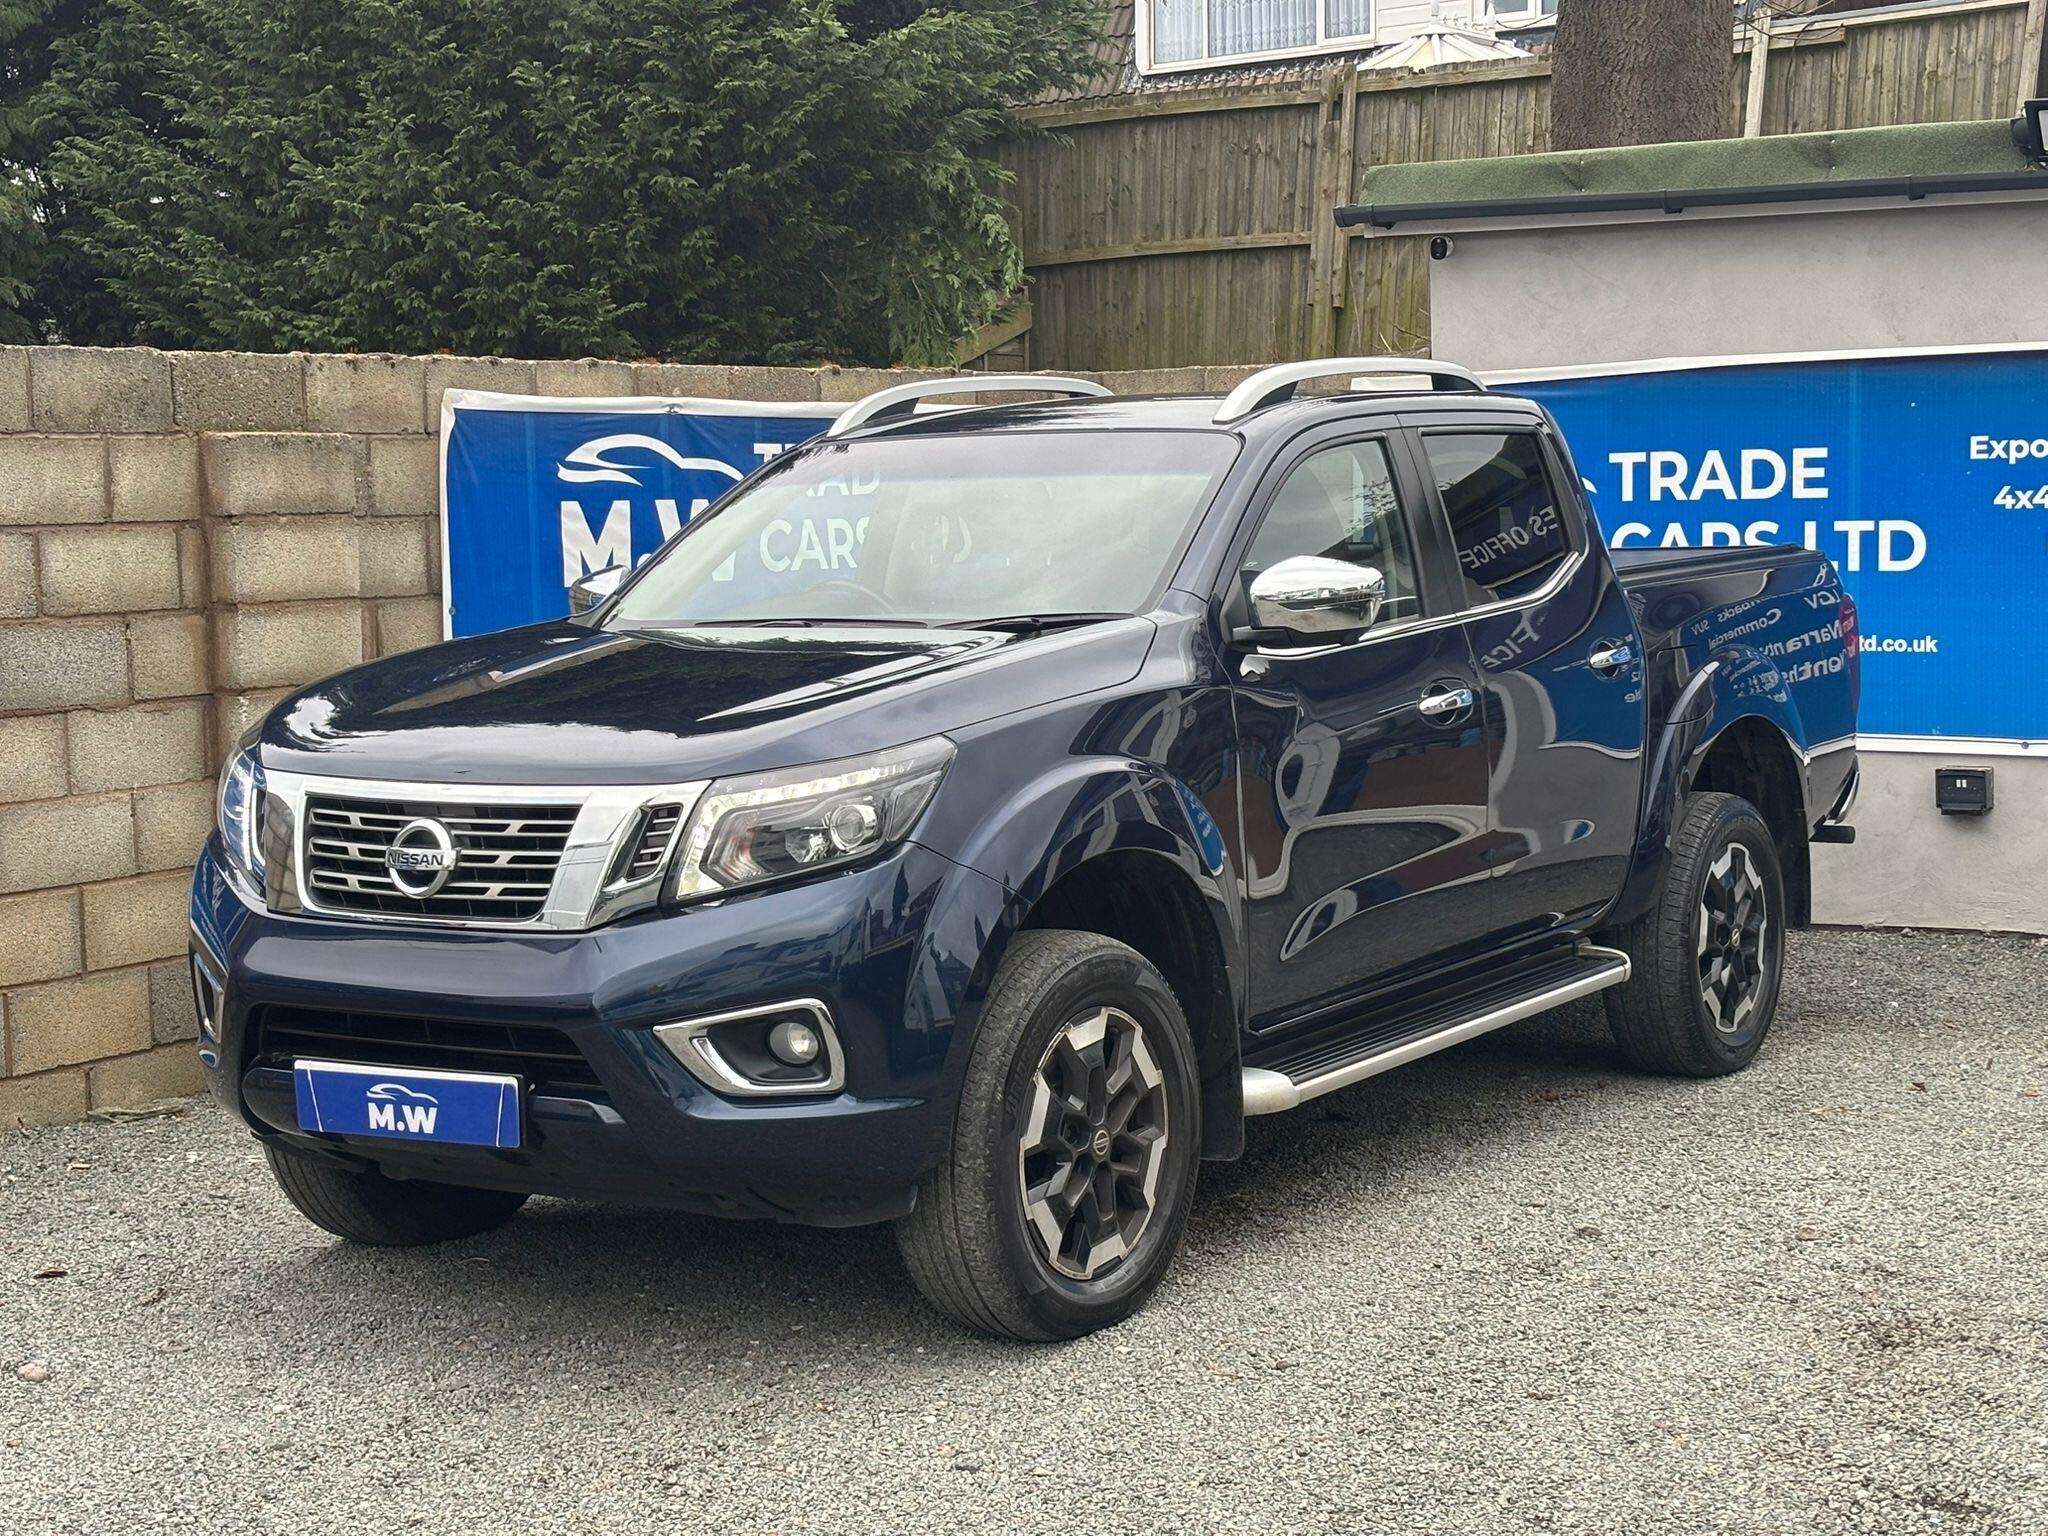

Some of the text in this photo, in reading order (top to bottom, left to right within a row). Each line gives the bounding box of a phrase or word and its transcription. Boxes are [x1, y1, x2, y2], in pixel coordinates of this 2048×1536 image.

[1970, 435, 2048, 465] Expo
[1608, 446, 1829, 502] TRADE
[1804, 519, 1927, 572] LTD
[388, 850, 444, 867] NISSAN
[367, 1102, 438, 1134] M.W
